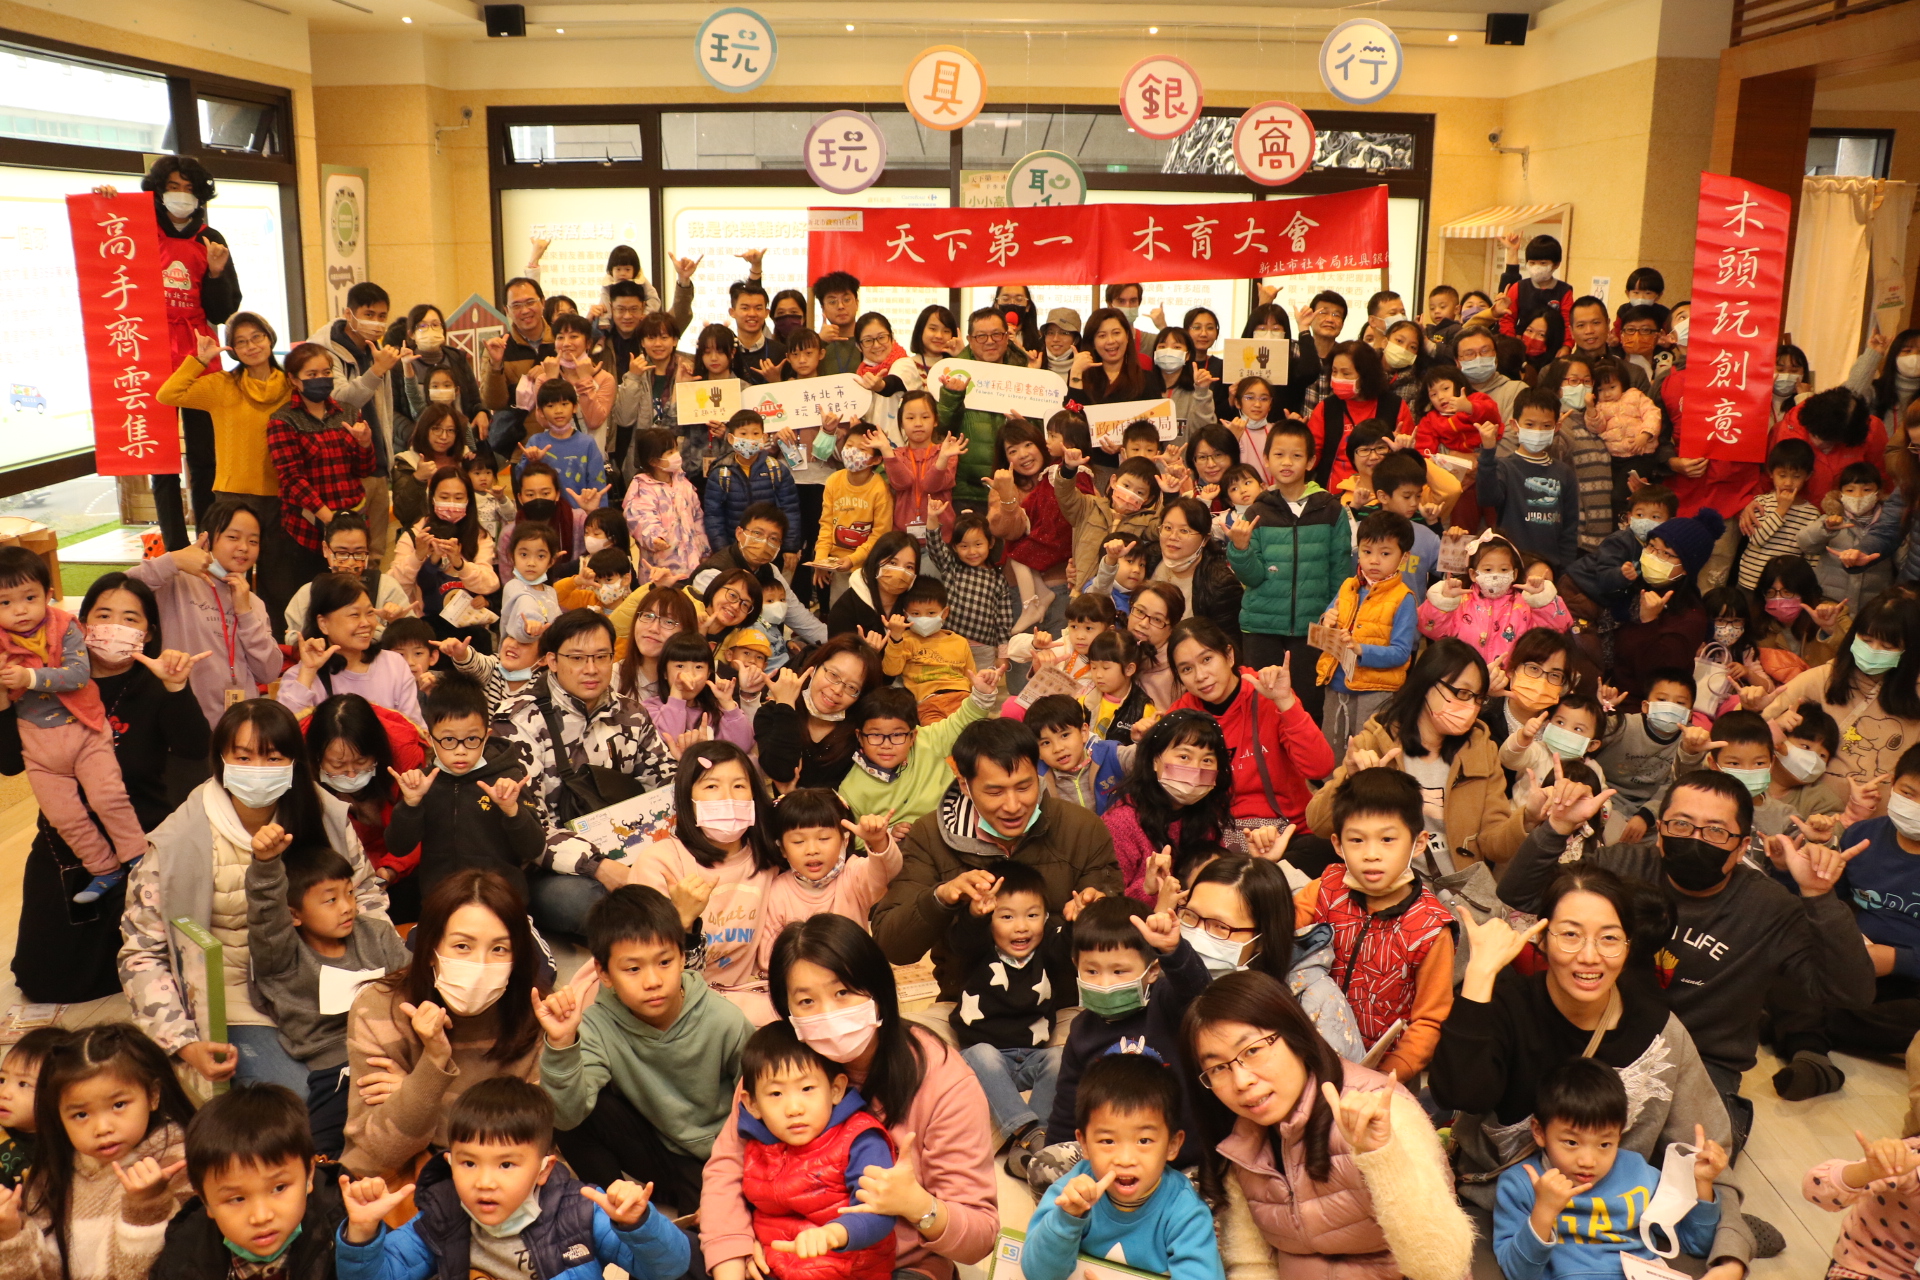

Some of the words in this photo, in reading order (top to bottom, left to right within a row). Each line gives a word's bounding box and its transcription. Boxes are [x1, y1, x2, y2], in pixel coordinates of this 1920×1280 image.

[709, 28, 762, 75] 玩
[1334, 40, 1388, 86] 行
[924, 60, 964, 117] 具
[1140, 72, 1189, 122] 銀
[818, 130, 873, 176] 玩
[886, 219, 1074, 268] 天下第一
[1132, 210, 1320, 261] 木育大會
[96, 212, 160, 460] 高手齊雲集
[1703, 190, 1765, 446] 木頭玩創意
[1682, 927, 1730, 961] LIFE
[1002, 1246, 1017, 1257] BS
